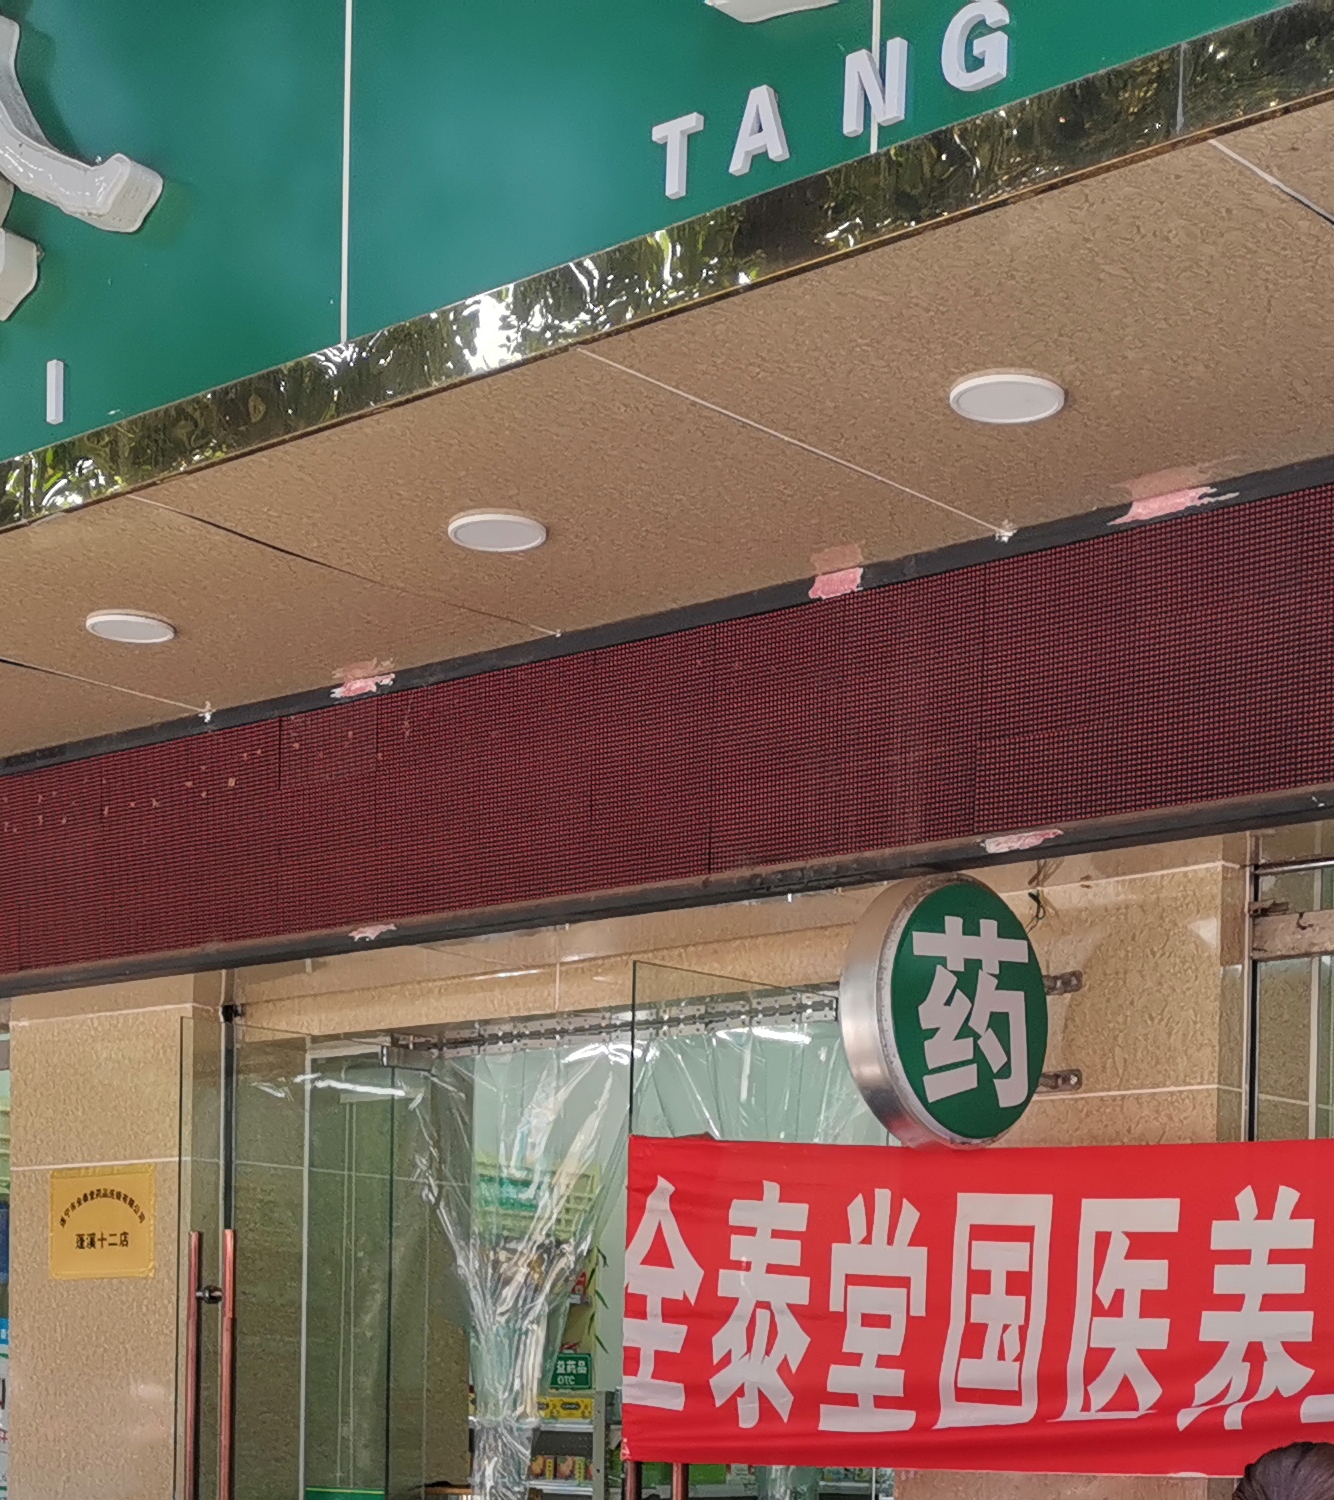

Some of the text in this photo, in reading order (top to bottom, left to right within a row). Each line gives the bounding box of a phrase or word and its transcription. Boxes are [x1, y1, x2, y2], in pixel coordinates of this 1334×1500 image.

[651, 0, 1011, 200] TANG
[912, 917, 1029, 1109] 药
[75, 1231, 129, 1249] 蓬溪十二店
[557, 1375, 576, 1385] OTC
